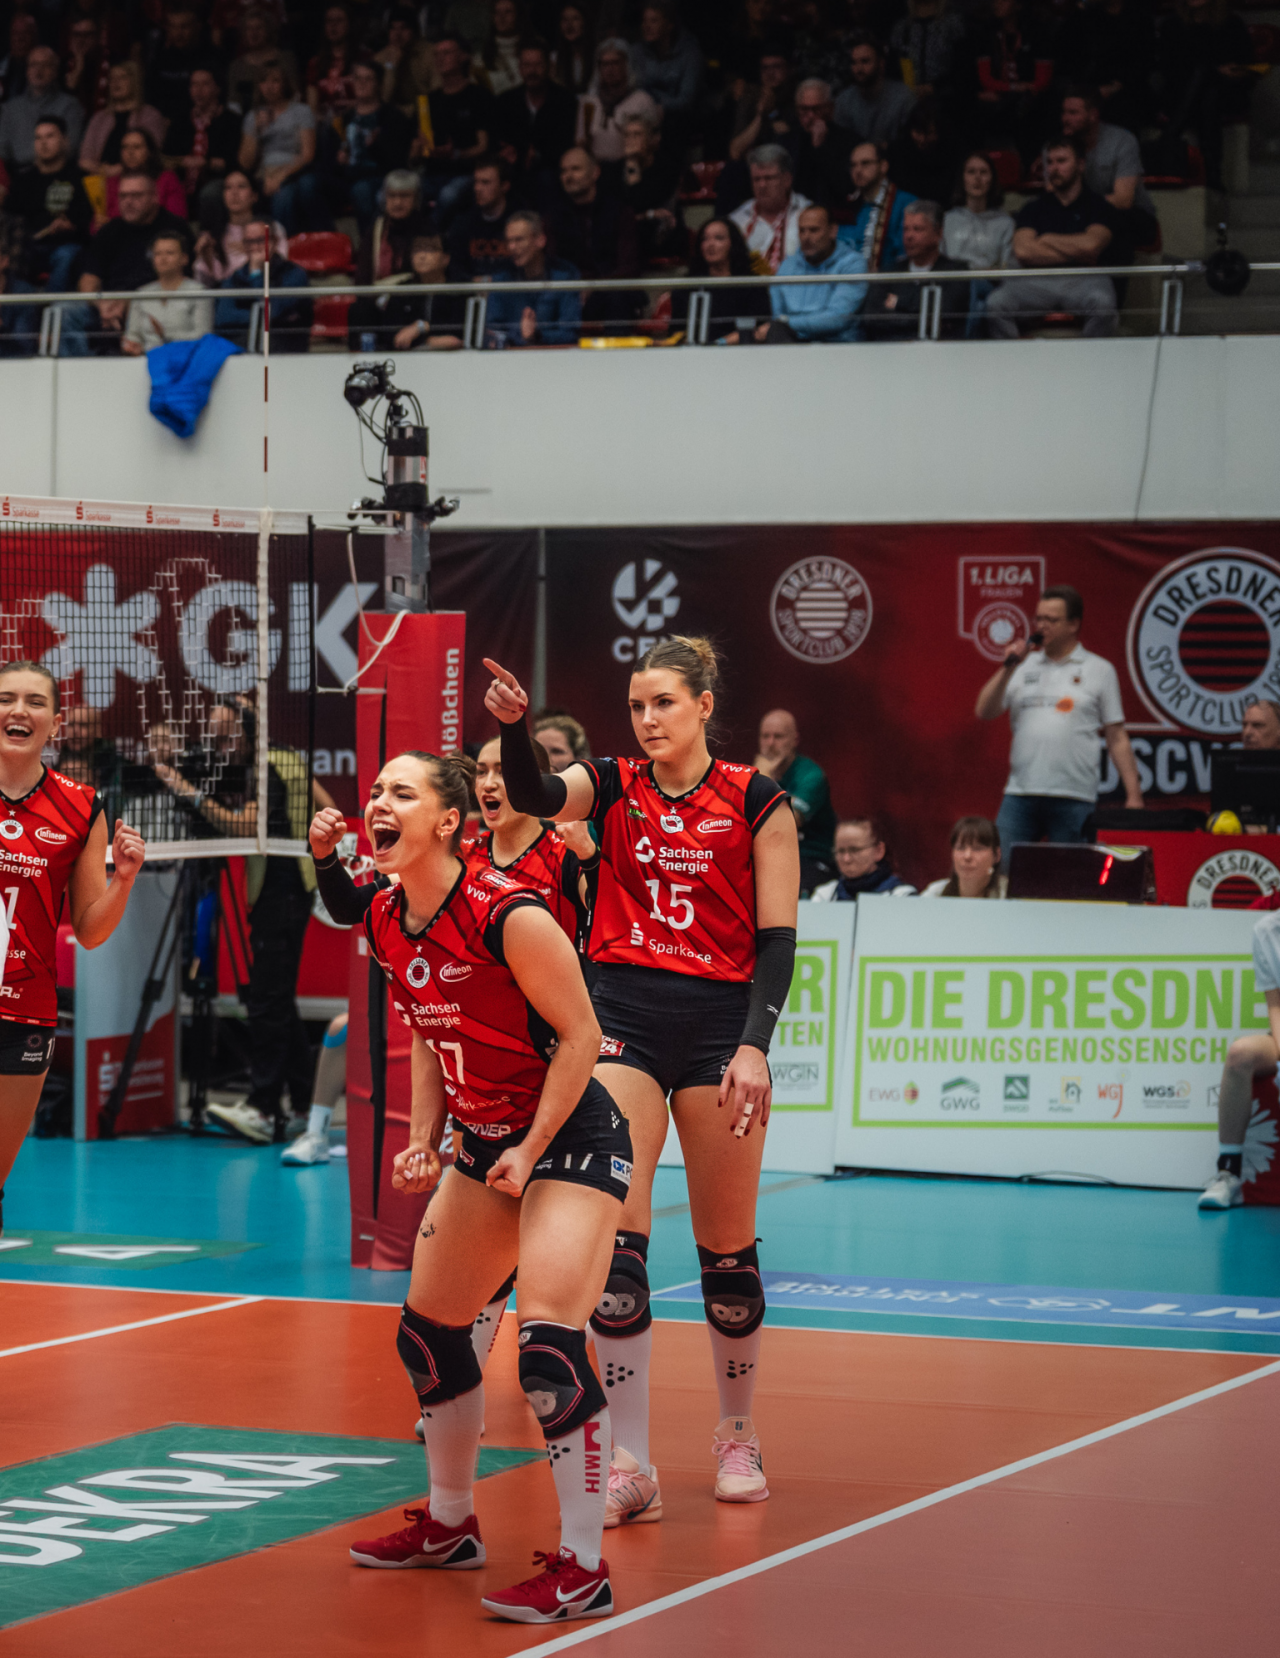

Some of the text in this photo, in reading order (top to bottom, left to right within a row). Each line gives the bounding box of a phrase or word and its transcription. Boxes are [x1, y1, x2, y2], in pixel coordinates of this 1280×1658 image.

[780, 561, 864, 601] DRESDNER
[180, 580, 379, 696] GK
[722, 764, 743, 773] VVO
[54, 773, 74, 788] VVO
[39, 828, 67, 841] Infineon
[658, 846, 714, 860] Sachsen
[658, 859, 709, 874] Energie
[467, 884, 486, 902] VVO
[645, 878, 695, 931] 15
[443, 964, 473, 977] Infineon
[868, 969, 966, 1031] DIE
[411, 1002, 461, 1016] Sachsen
[415, 1014, 462, 1029] Energie
[425, 1038, 466, 1086] 17
[869, 1087, 901, 1102] EWG
[1142, 1084, 1173, 1099] WGS
[940, 1096, 981, 1112] GWG
